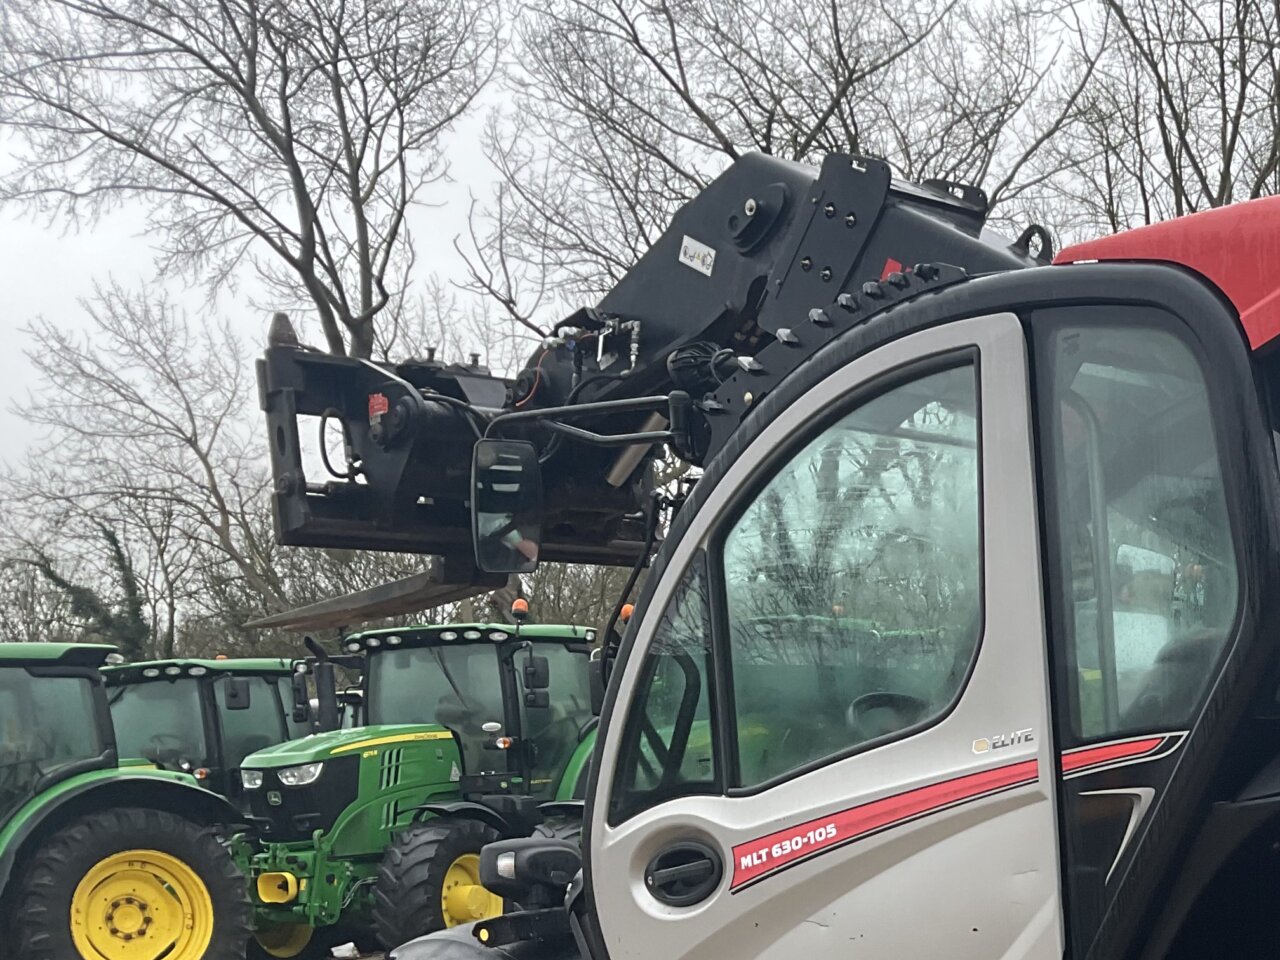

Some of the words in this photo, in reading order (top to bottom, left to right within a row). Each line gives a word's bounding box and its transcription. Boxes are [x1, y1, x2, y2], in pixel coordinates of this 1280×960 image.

[992, 727, 1034, 750] ELITE
[740, 847, 769, 870] MLT
[771, 823, 837, 858] 630-105
